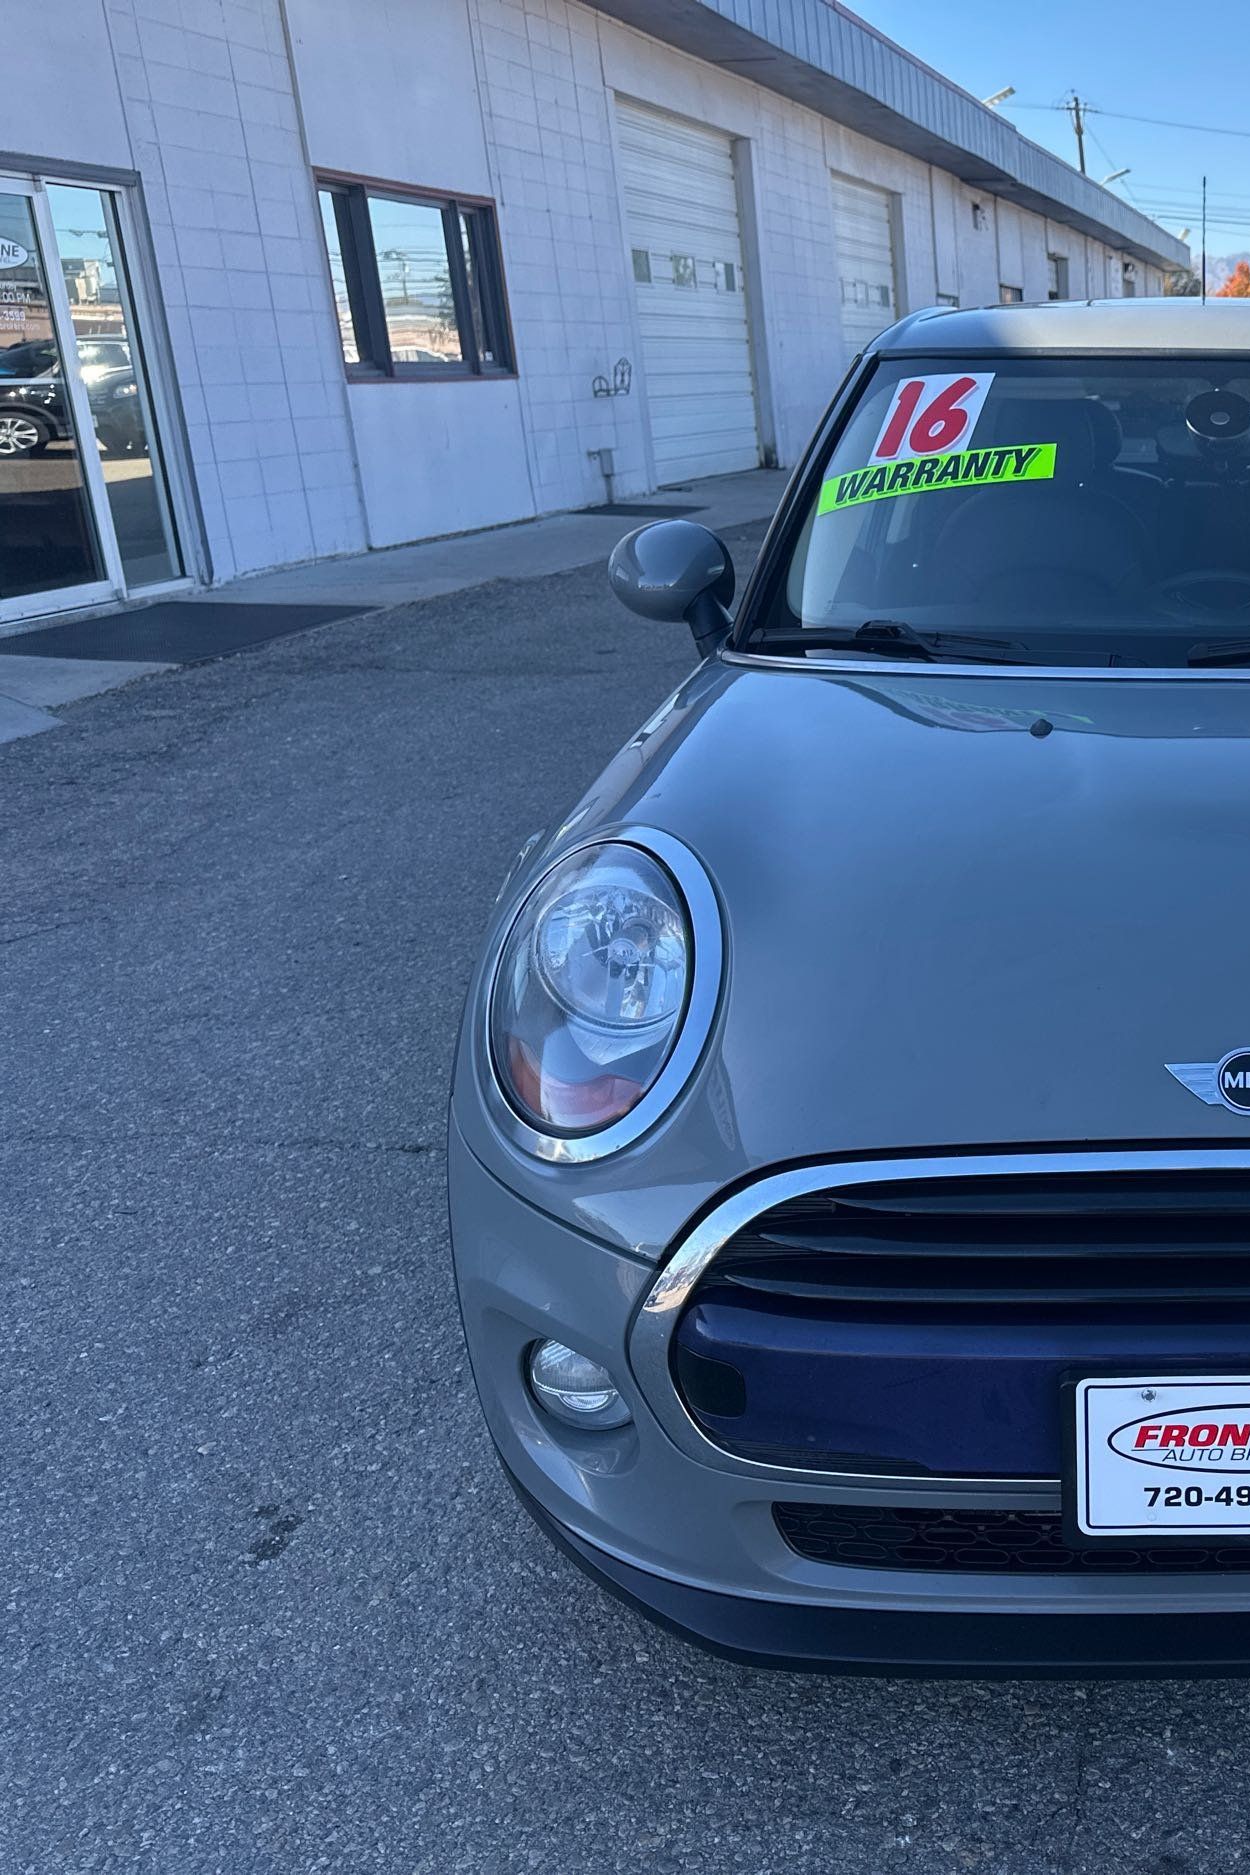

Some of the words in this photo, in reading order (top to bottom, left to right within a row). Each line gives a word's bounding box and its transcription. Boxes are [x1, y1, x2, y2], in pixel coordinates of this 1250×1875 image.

[875, 376, 978, 458] 16
[834, 447, 1042, 506] WARRANTY
[1161, 1447, 1224, 1462] AUTO
